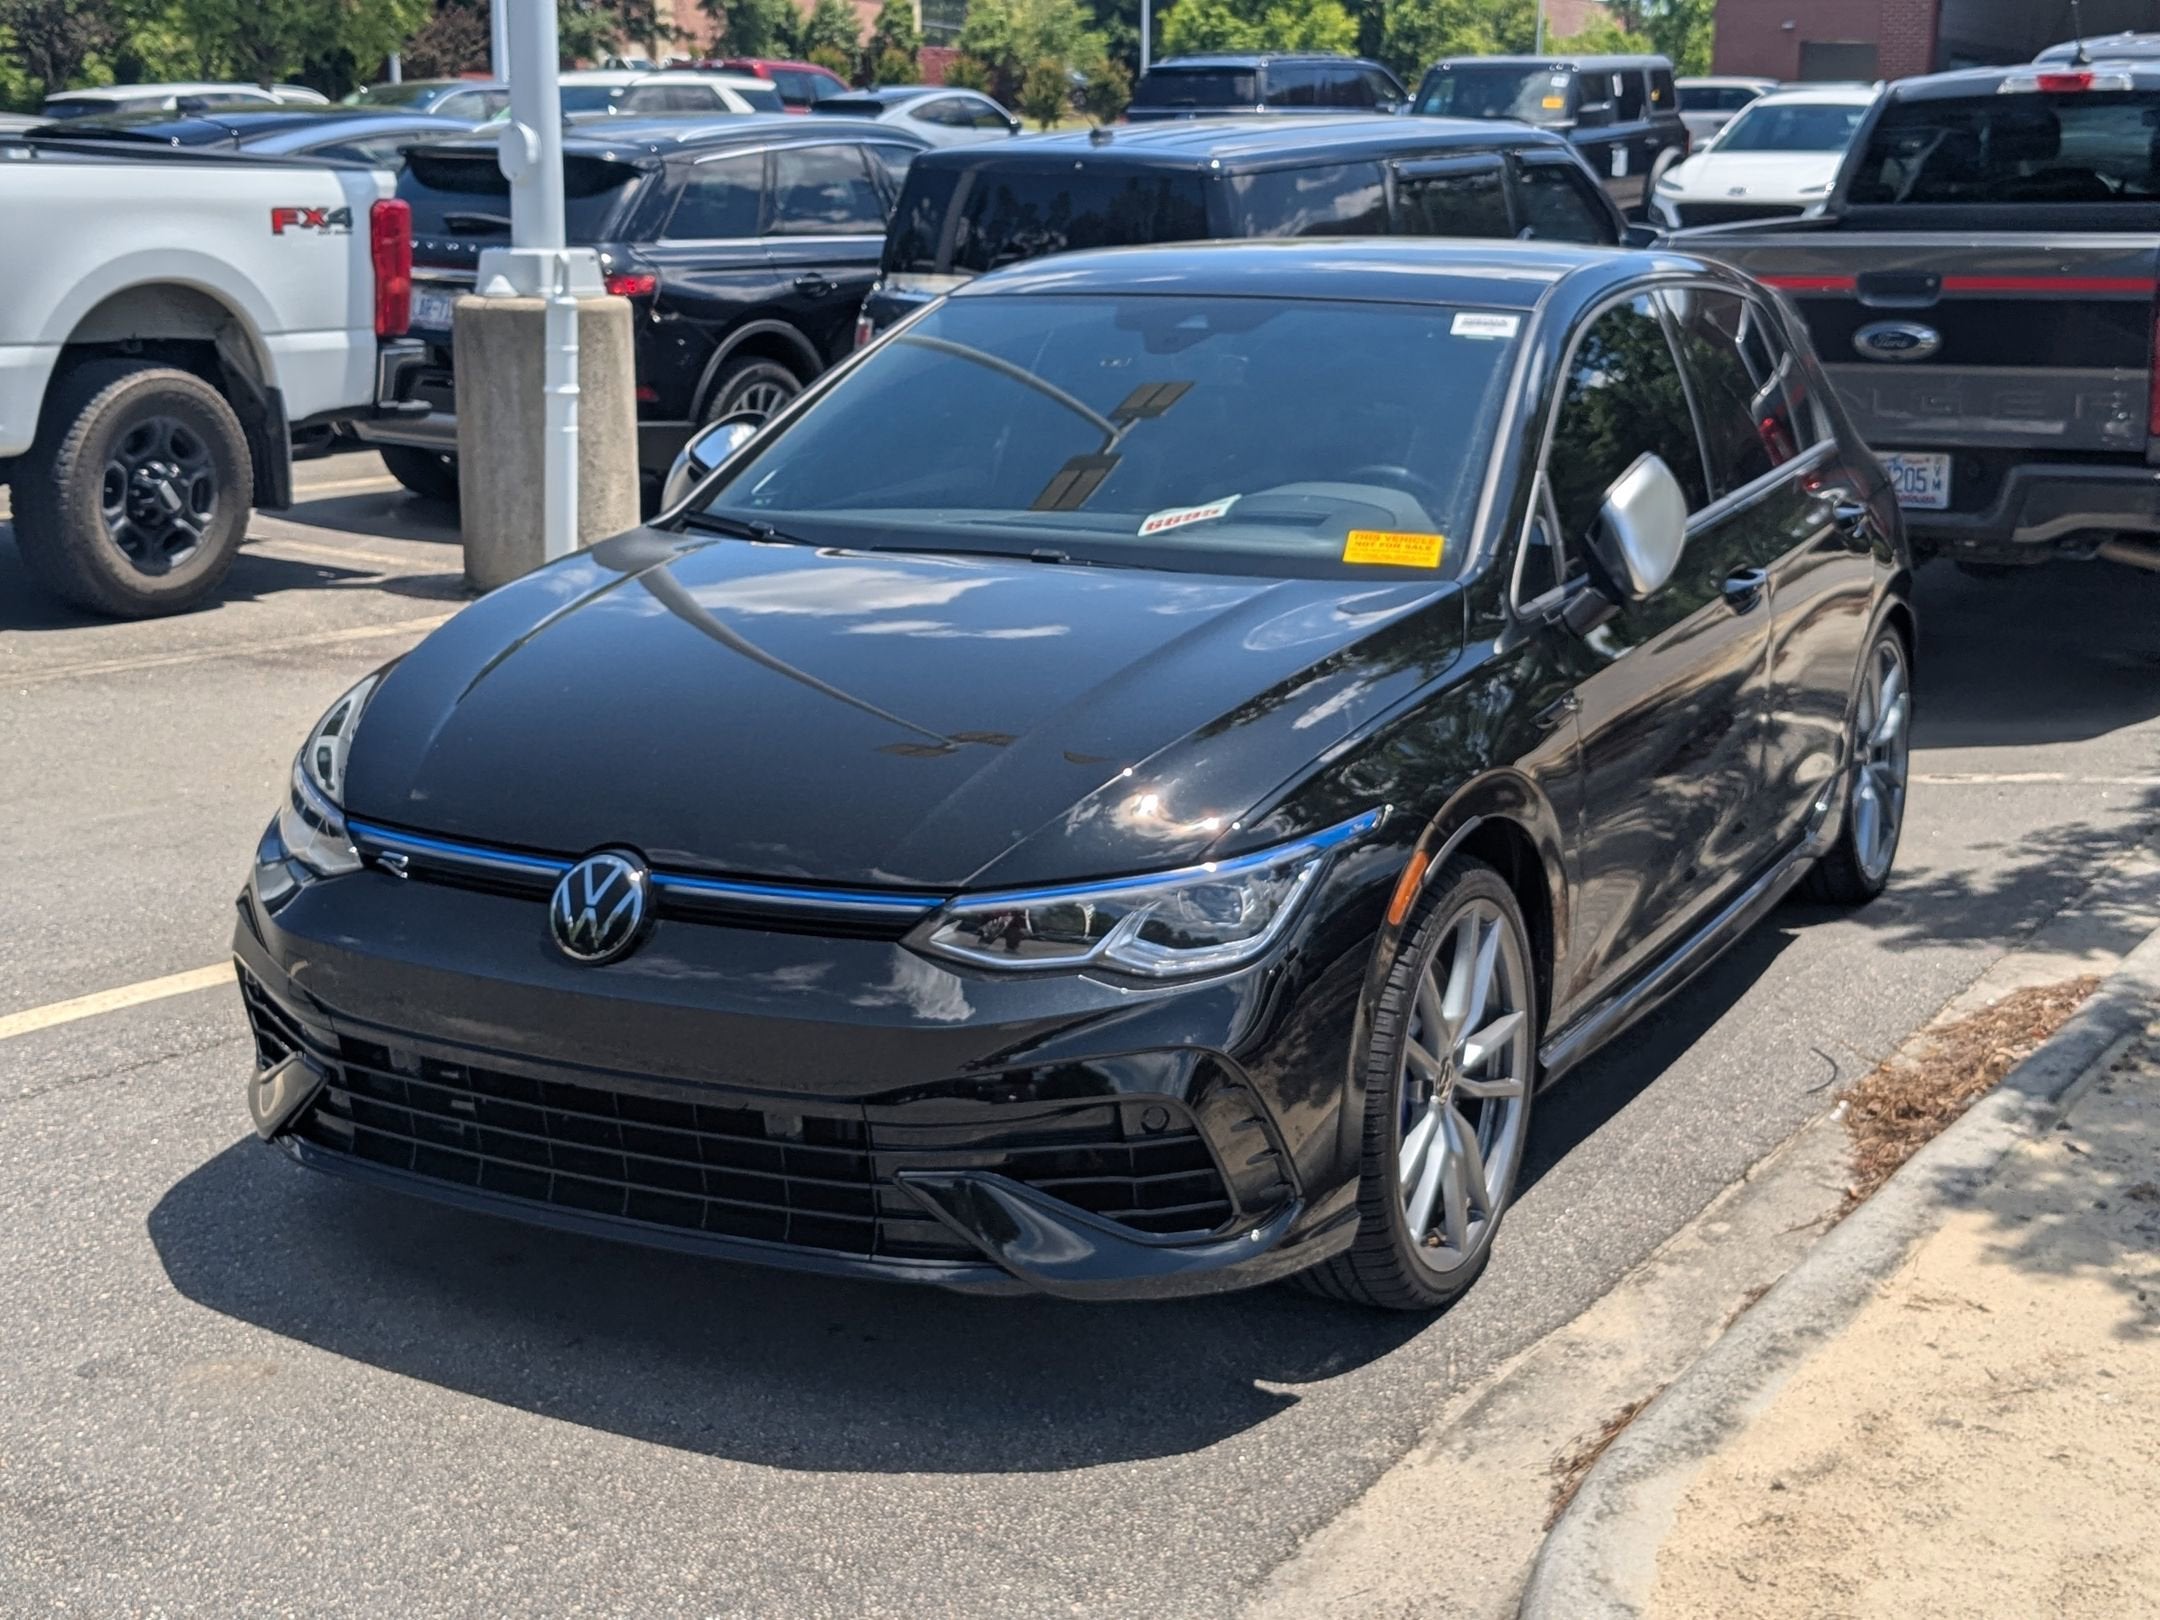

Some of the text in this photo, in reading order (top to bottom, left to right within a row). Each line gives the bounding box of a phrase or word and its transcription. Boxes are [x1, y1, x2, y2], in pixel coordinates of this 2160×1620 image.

[271, 207, 353, 235] FX4
[1887, 465, 1927, 493] 205
[1385, 536, 1435, 544] VEHICLE
